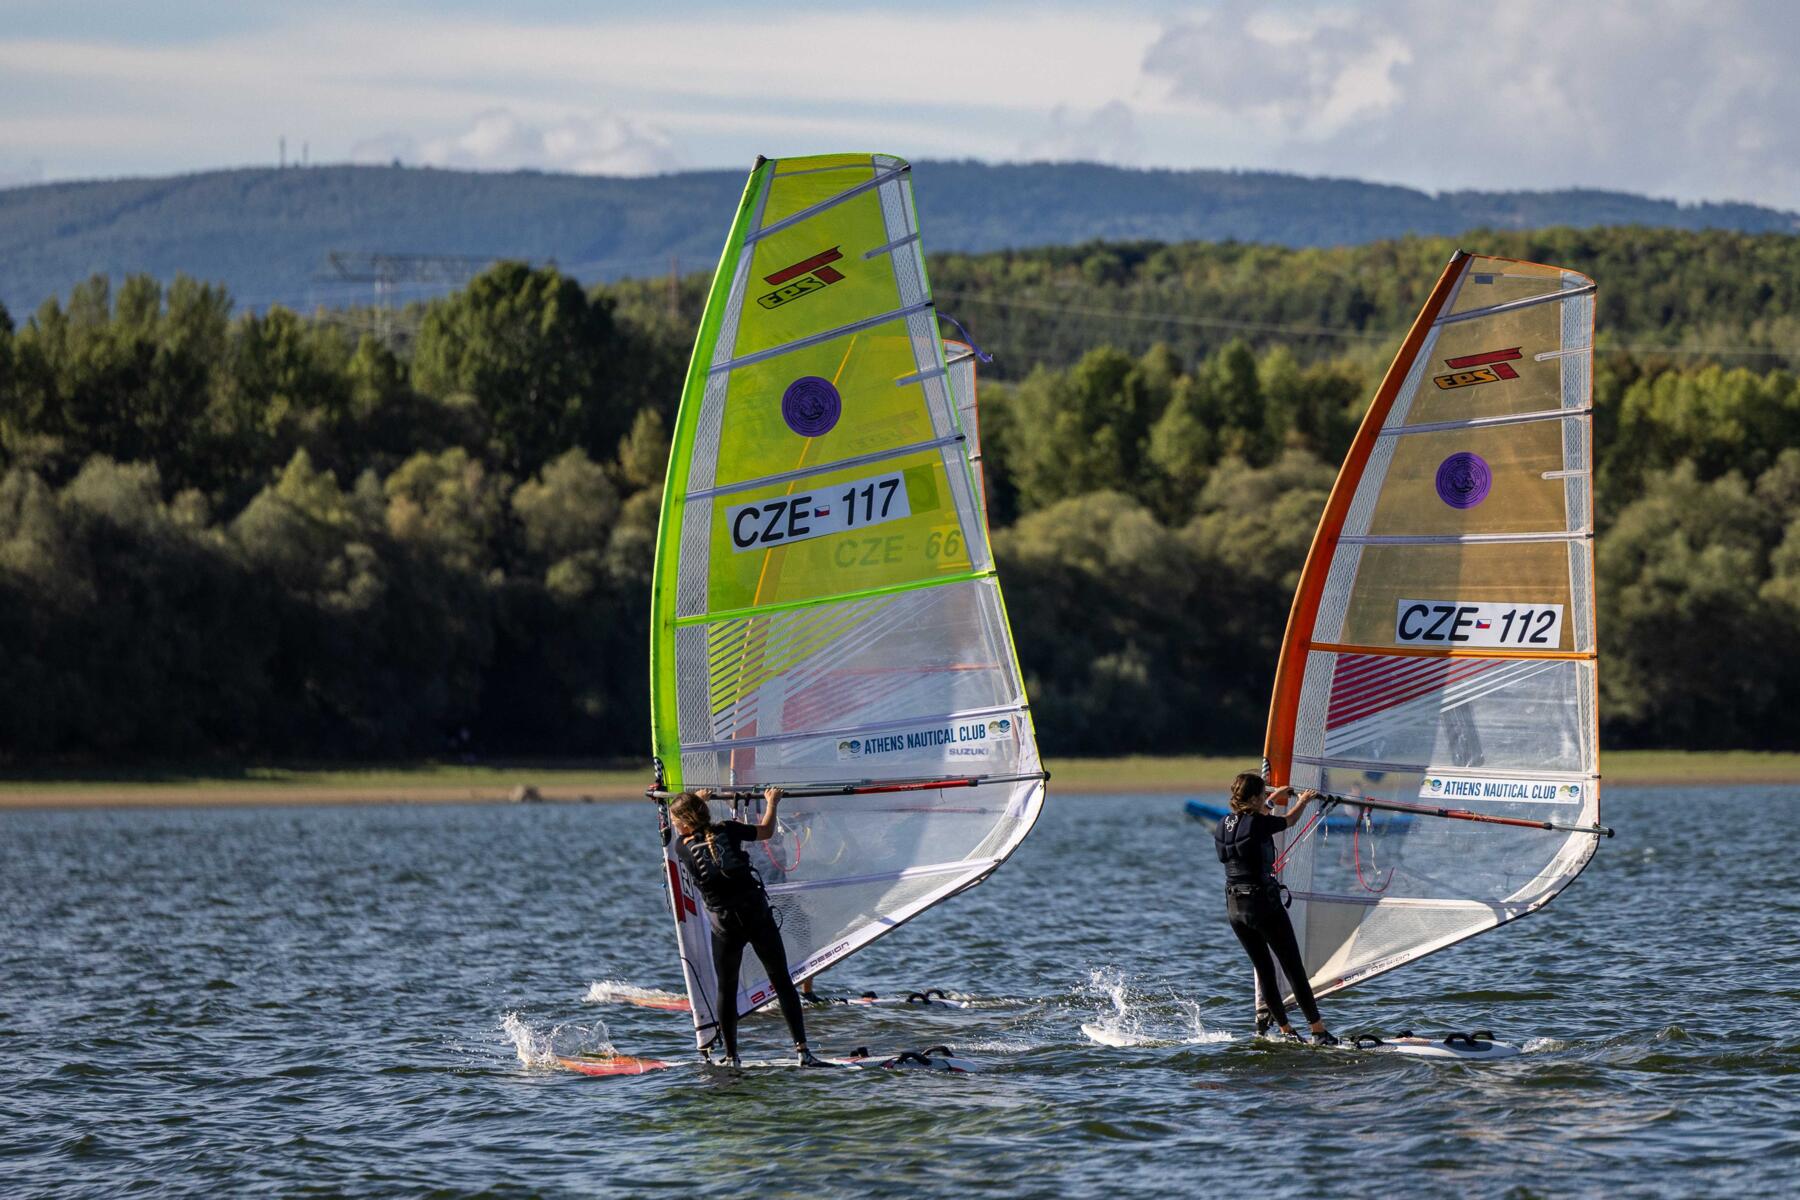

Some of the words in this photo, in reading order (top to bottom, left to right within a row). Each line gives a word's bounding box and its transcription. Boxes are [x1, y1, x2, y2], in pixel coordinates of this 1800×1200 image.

[733, 496, 812, 548] CZE
[842, 478, 900, 526] 117
[834, 535, 905, 568] CZE
[925, 529, 961, 560] 66
[1398, 604, 1479, 642] CZE
[1500, 609, 1557, 643] 112
[864, 735, 904, 755] ATHENS
[907, 728, 957, 749] NAUTICAL
[959, 723, 986, 742] CLUB
[949, 747, 989, 756] SUZUKI
[1444, 781, 1481, 797] ATHENS
[1483, 783, 1529, 799] NAUTICAL
[1531, 785, 1557, 800] CLUB
